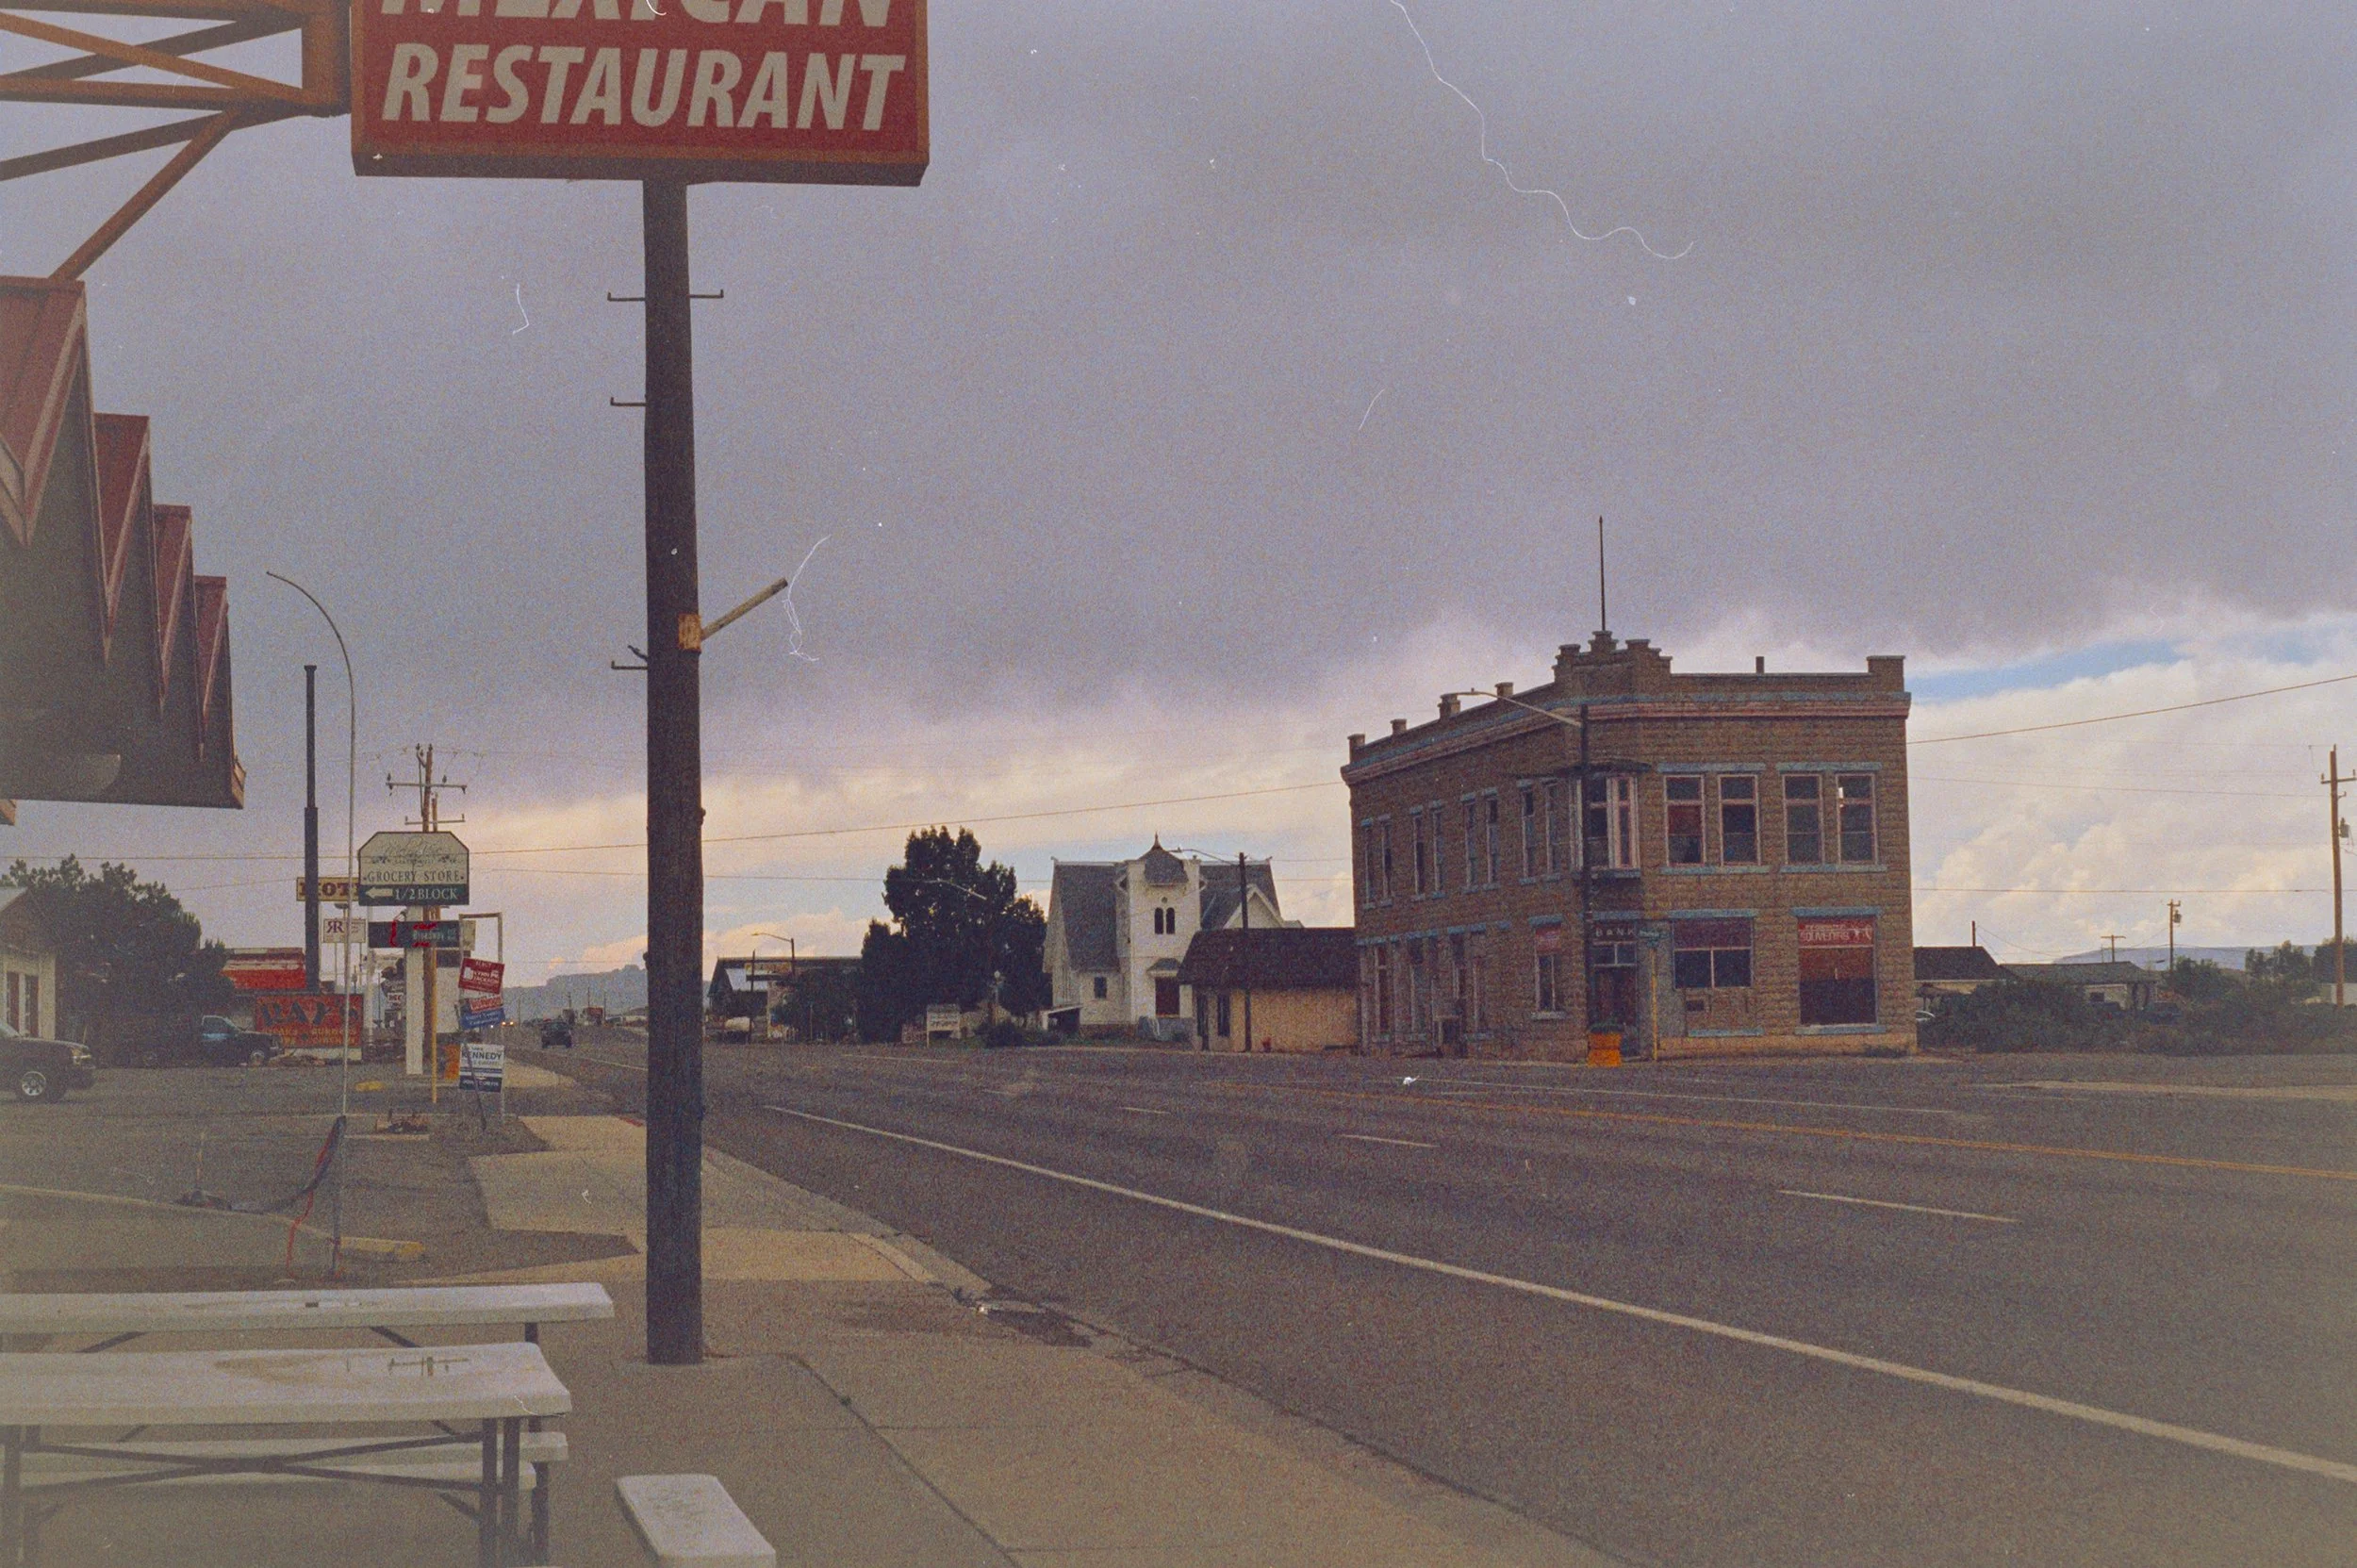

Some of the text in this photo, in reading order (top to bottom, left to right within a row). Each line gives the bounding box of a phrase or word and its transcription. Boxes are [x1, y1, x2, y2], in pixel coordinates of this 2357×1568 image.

[381, 42, 906, 132] RESTAURANT
[368, 870, 460, 883] GROCERY STORE
[394, 887, 458, 900] 1/2 BLOCK
